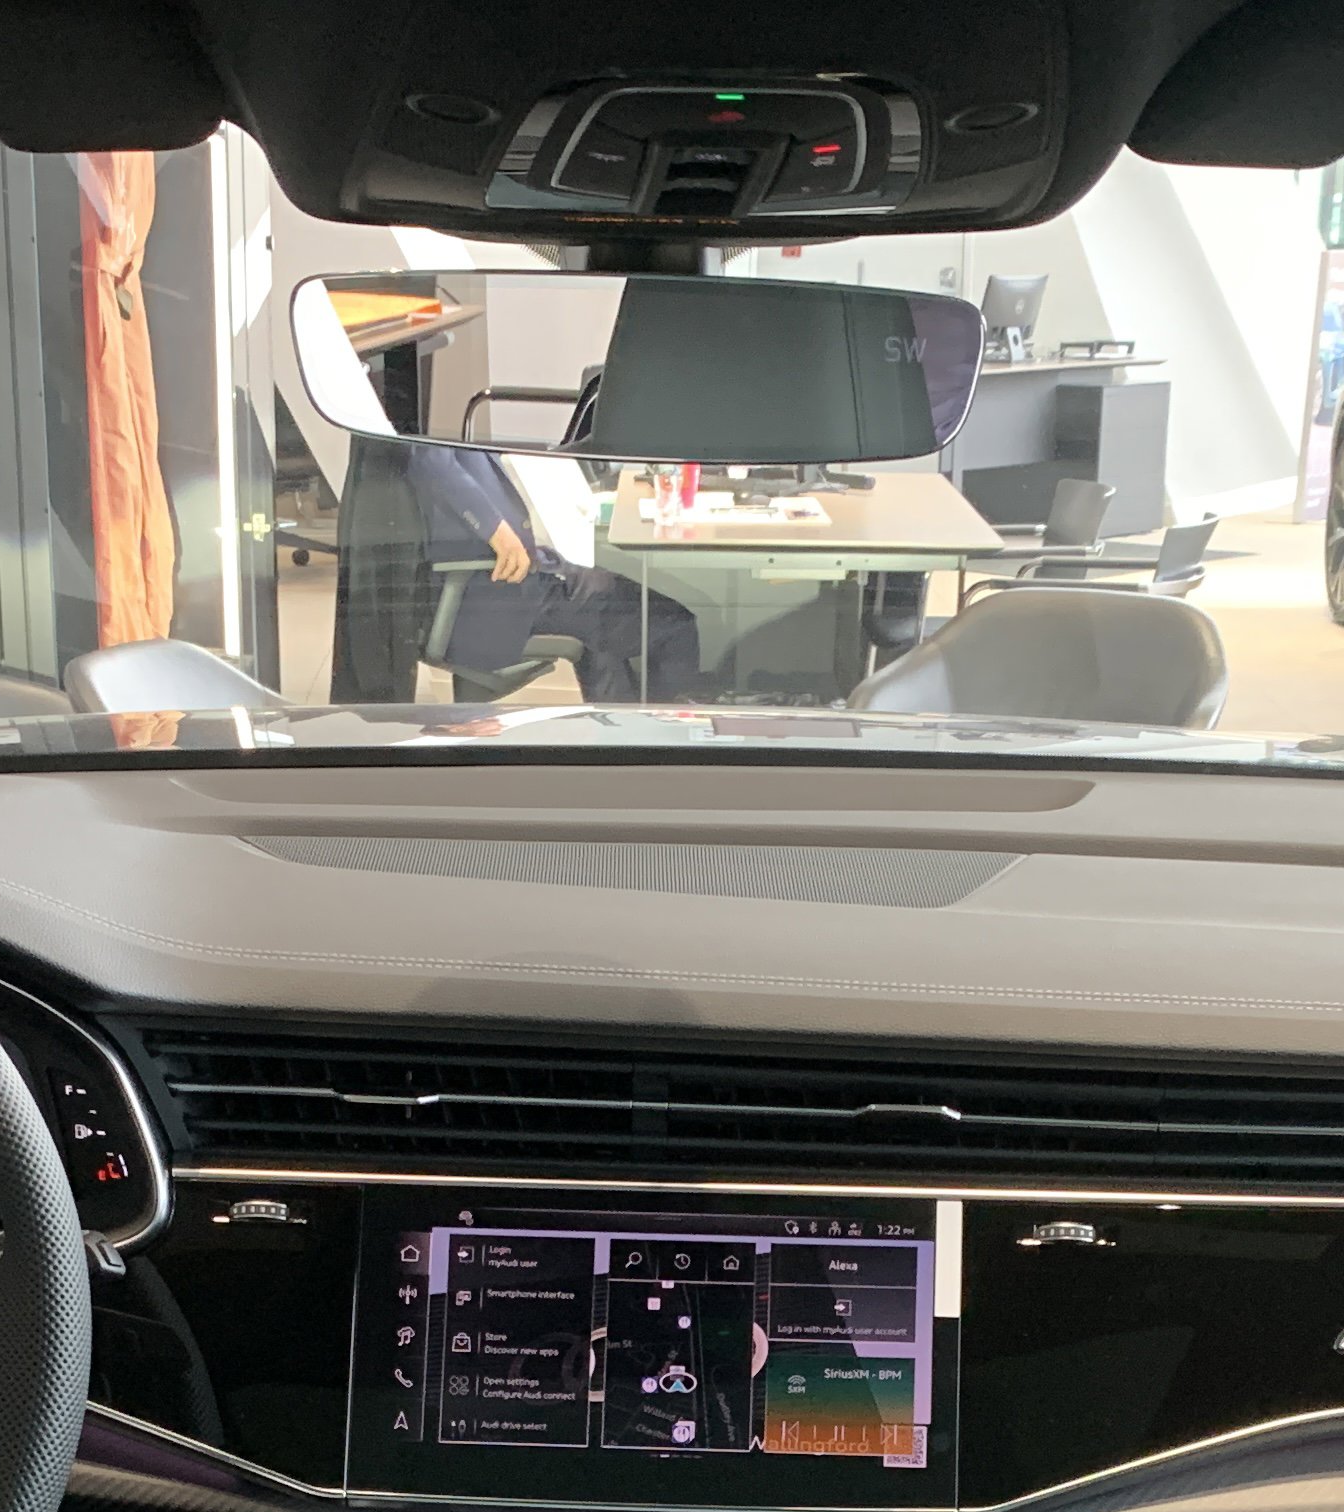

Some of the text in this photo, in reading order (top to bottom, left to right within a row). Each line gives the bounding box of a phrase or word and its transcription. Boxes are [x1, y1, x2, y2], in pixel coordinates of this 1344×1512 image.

[64, 1085, 73, 1096] F
[876, 1224, 900, 1236] 1:22
[489, 1245, 512, 1255] Login
[828, 1260, 858, 1271] Alexa
[487, 1289, 575, 1300] Smartphone interface
[777, 1325, 792, 1334] Log
[803, 1325, 821, 1333] with
[485, 1333, 507, 1341] Store
[484, 1345, 518, 1355] Discover
[539, 1348, 559, 1357] apps
[824, 1368, 870, 1380] SiriusXM
[878, 1370, 902, 1381] BPM
[483, 1377, 540, 1388] Open settings
[482, 1389, 576, 1401] Configure Audi connect
[787, 1385, 806, 1394] SXM
[481, 1421, 547, 1431] Audi drive select
